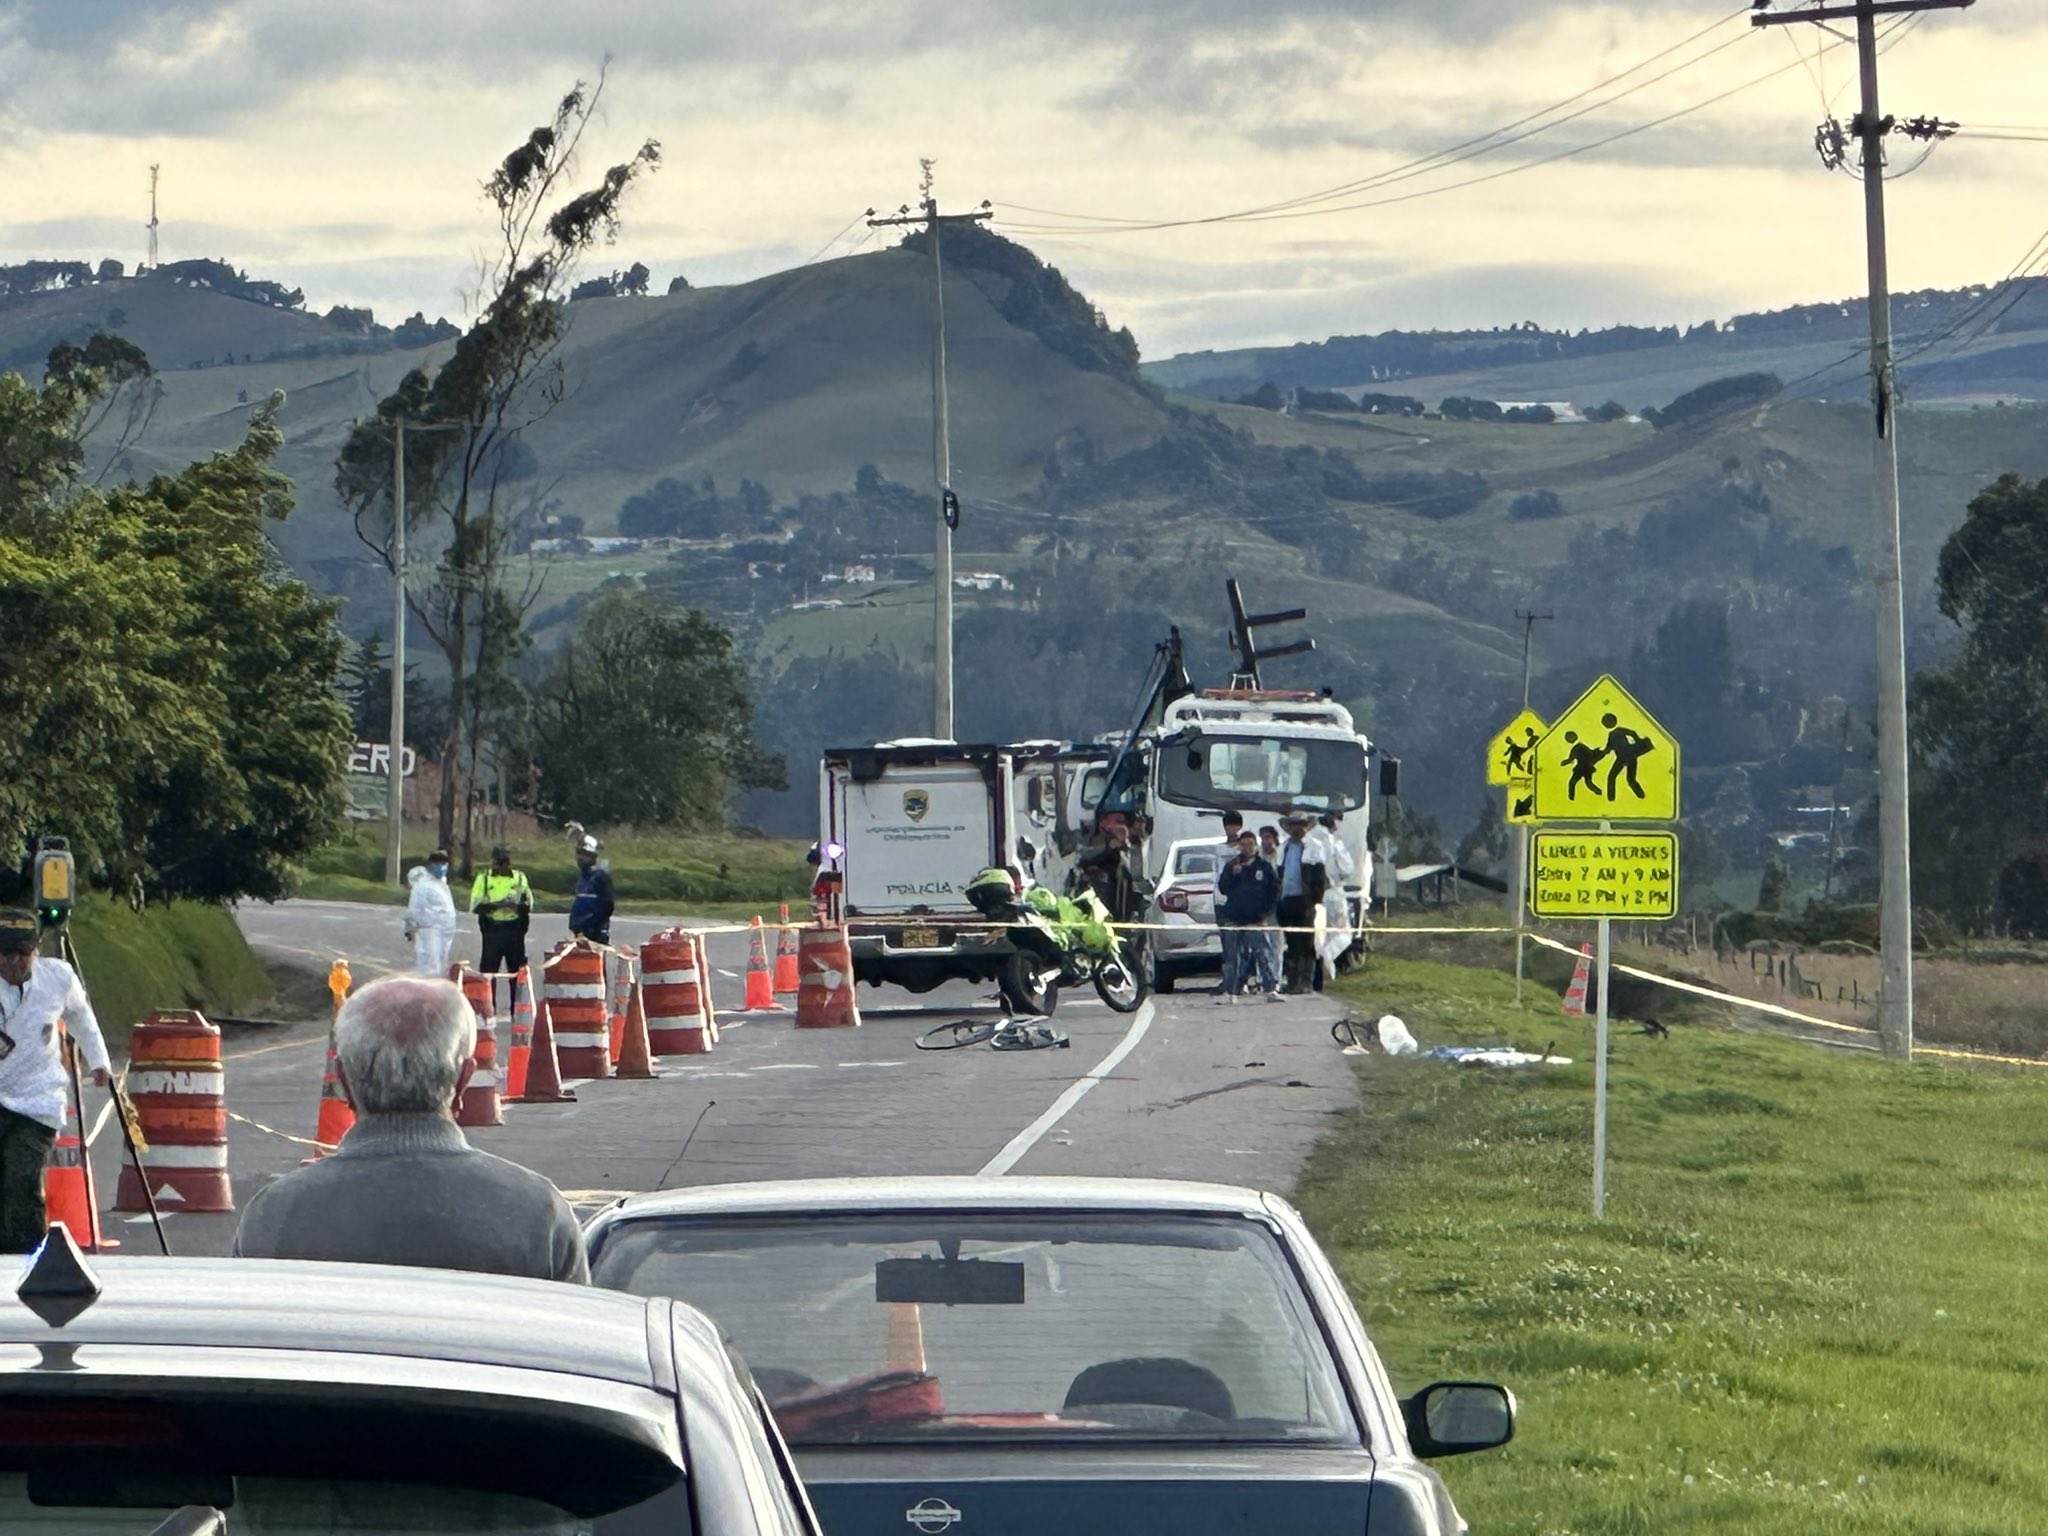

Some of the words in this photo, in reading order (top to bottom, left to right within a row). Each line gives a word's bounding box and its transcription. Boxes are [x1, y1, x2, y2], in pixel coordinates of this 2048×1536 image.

[1593, 845, 1603, 858] A
[1608, 845, 1669, 860] VIERNES
[1581, 866, 1589, 880] 7
[1597, 867, 1617, 881] AM
[1634, 867, 1644, 881] 9
[1649, 867, 1670, 881] AM
[1577, 889, 1590, 903] 12
[1596, 889, 1617, 904] PM
[1635, 889, 1644, 904] 2
[1649, 889, 1670, 905] PM
